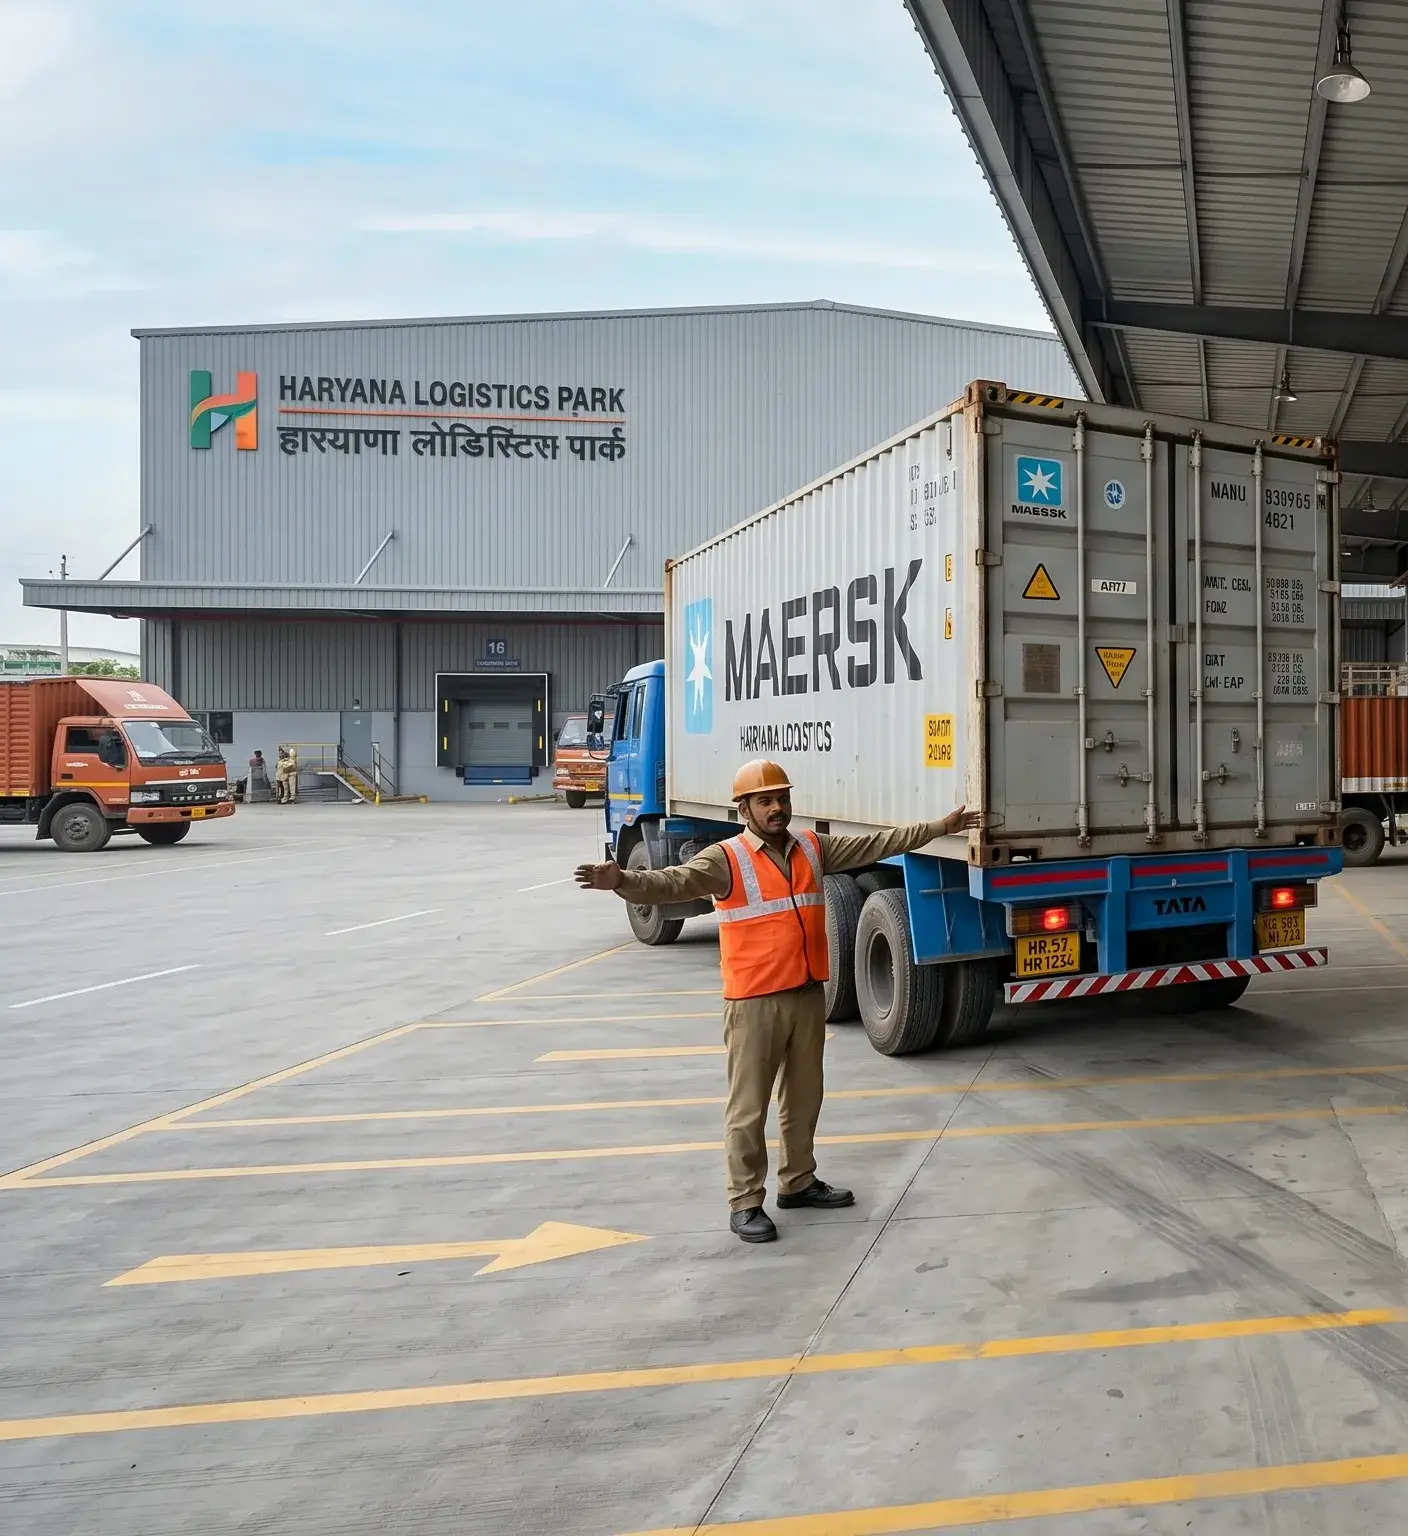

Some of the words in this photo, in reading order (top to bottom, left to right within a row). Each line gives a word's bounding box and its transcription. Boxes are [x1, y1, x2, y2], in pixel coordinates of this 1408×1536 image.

[279, 375, 407, 405] HARYANA
[414, 380, 550, 411] LOGISTICS
[558, 386, 626, 413] PARK
[565, 427, 626, 462] पार्क
[1211, 481, 1246, 501] MANU
[1011, 504, 1067, 519] MAESSK
[1264, 511, 1294, 530] 4621
[725, 558, 923, 702] MAERSK
[489, 641, 505, 654] 16
[1153, 896, 1208, 915] TATA
